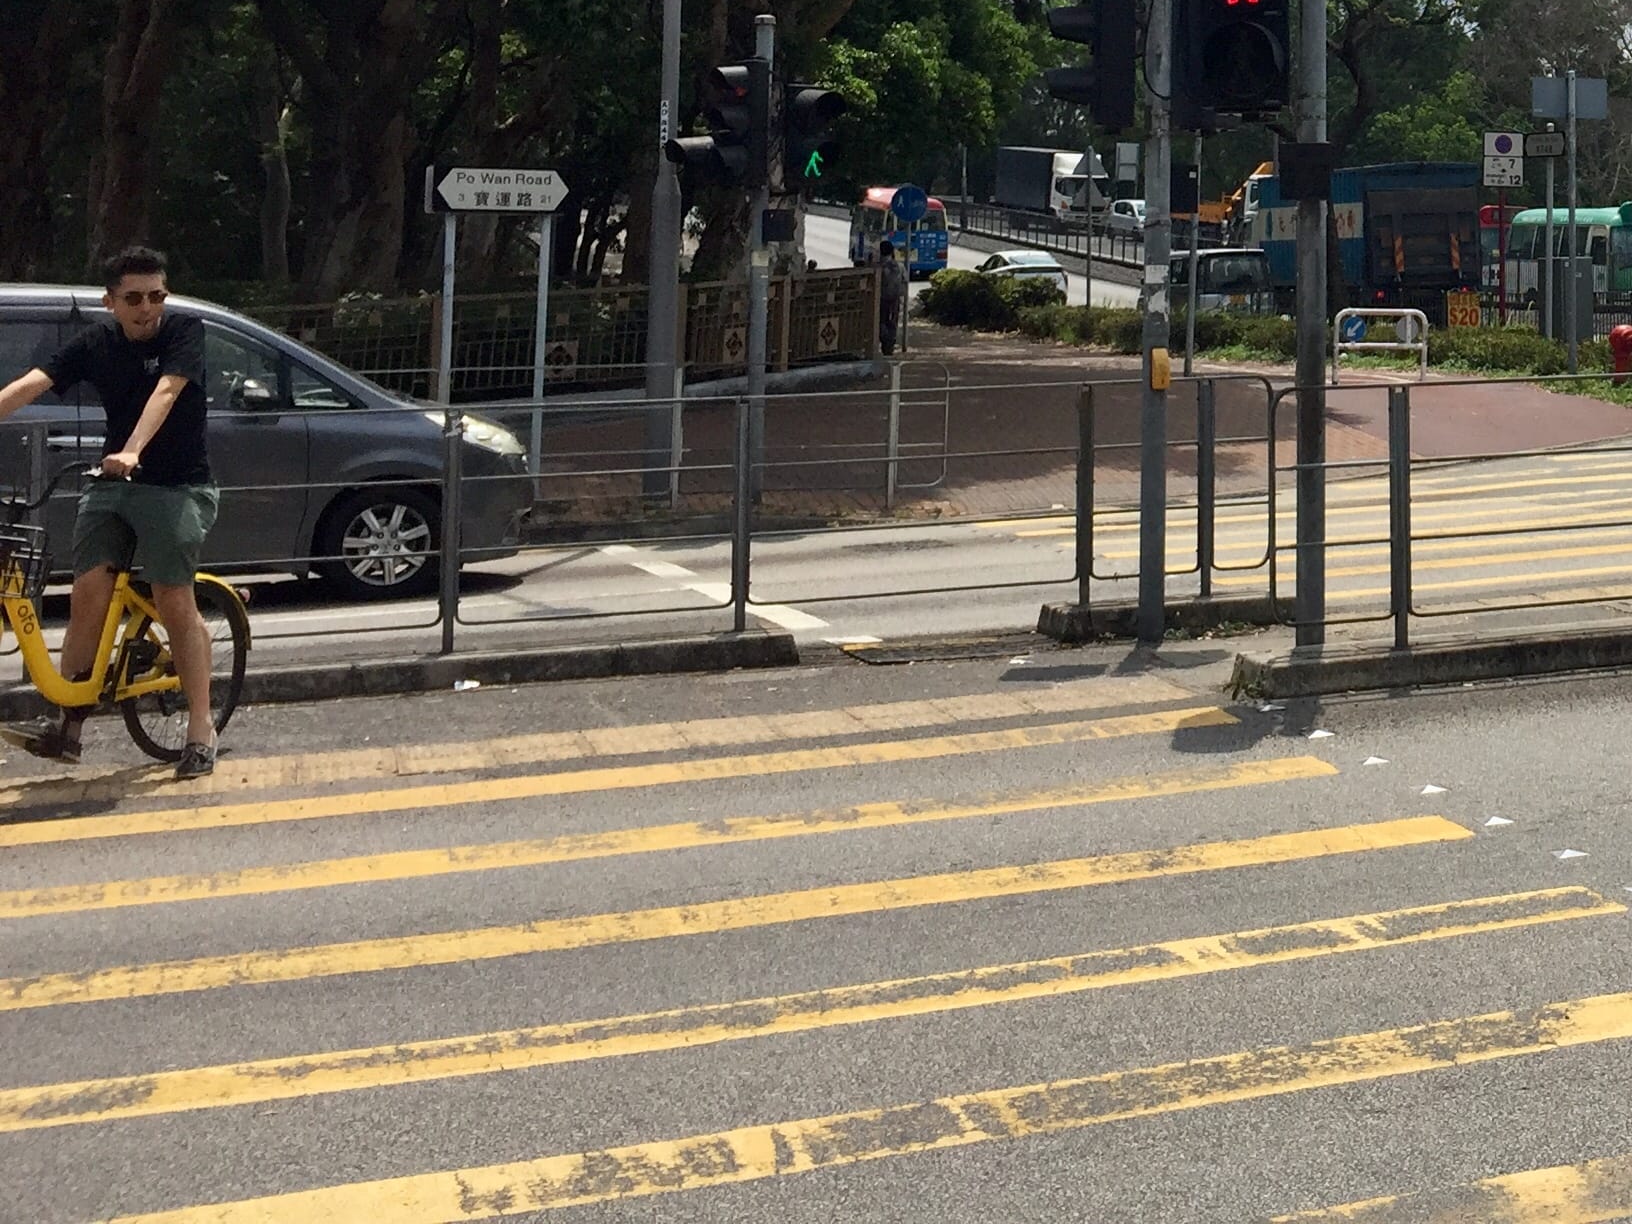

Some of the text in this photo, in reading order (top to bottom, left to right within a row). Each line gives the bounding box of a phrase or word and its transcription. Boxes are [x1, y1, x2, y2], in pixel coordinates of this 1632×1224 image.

[1508, 158, 1516, 169] 7
[456, 172, 552, 186] Po Wan Road
[1509, 174, 1521, 185] 12
[474, 191, 532, 207] 寶運路
[17, 604, 35, 636] ofo
